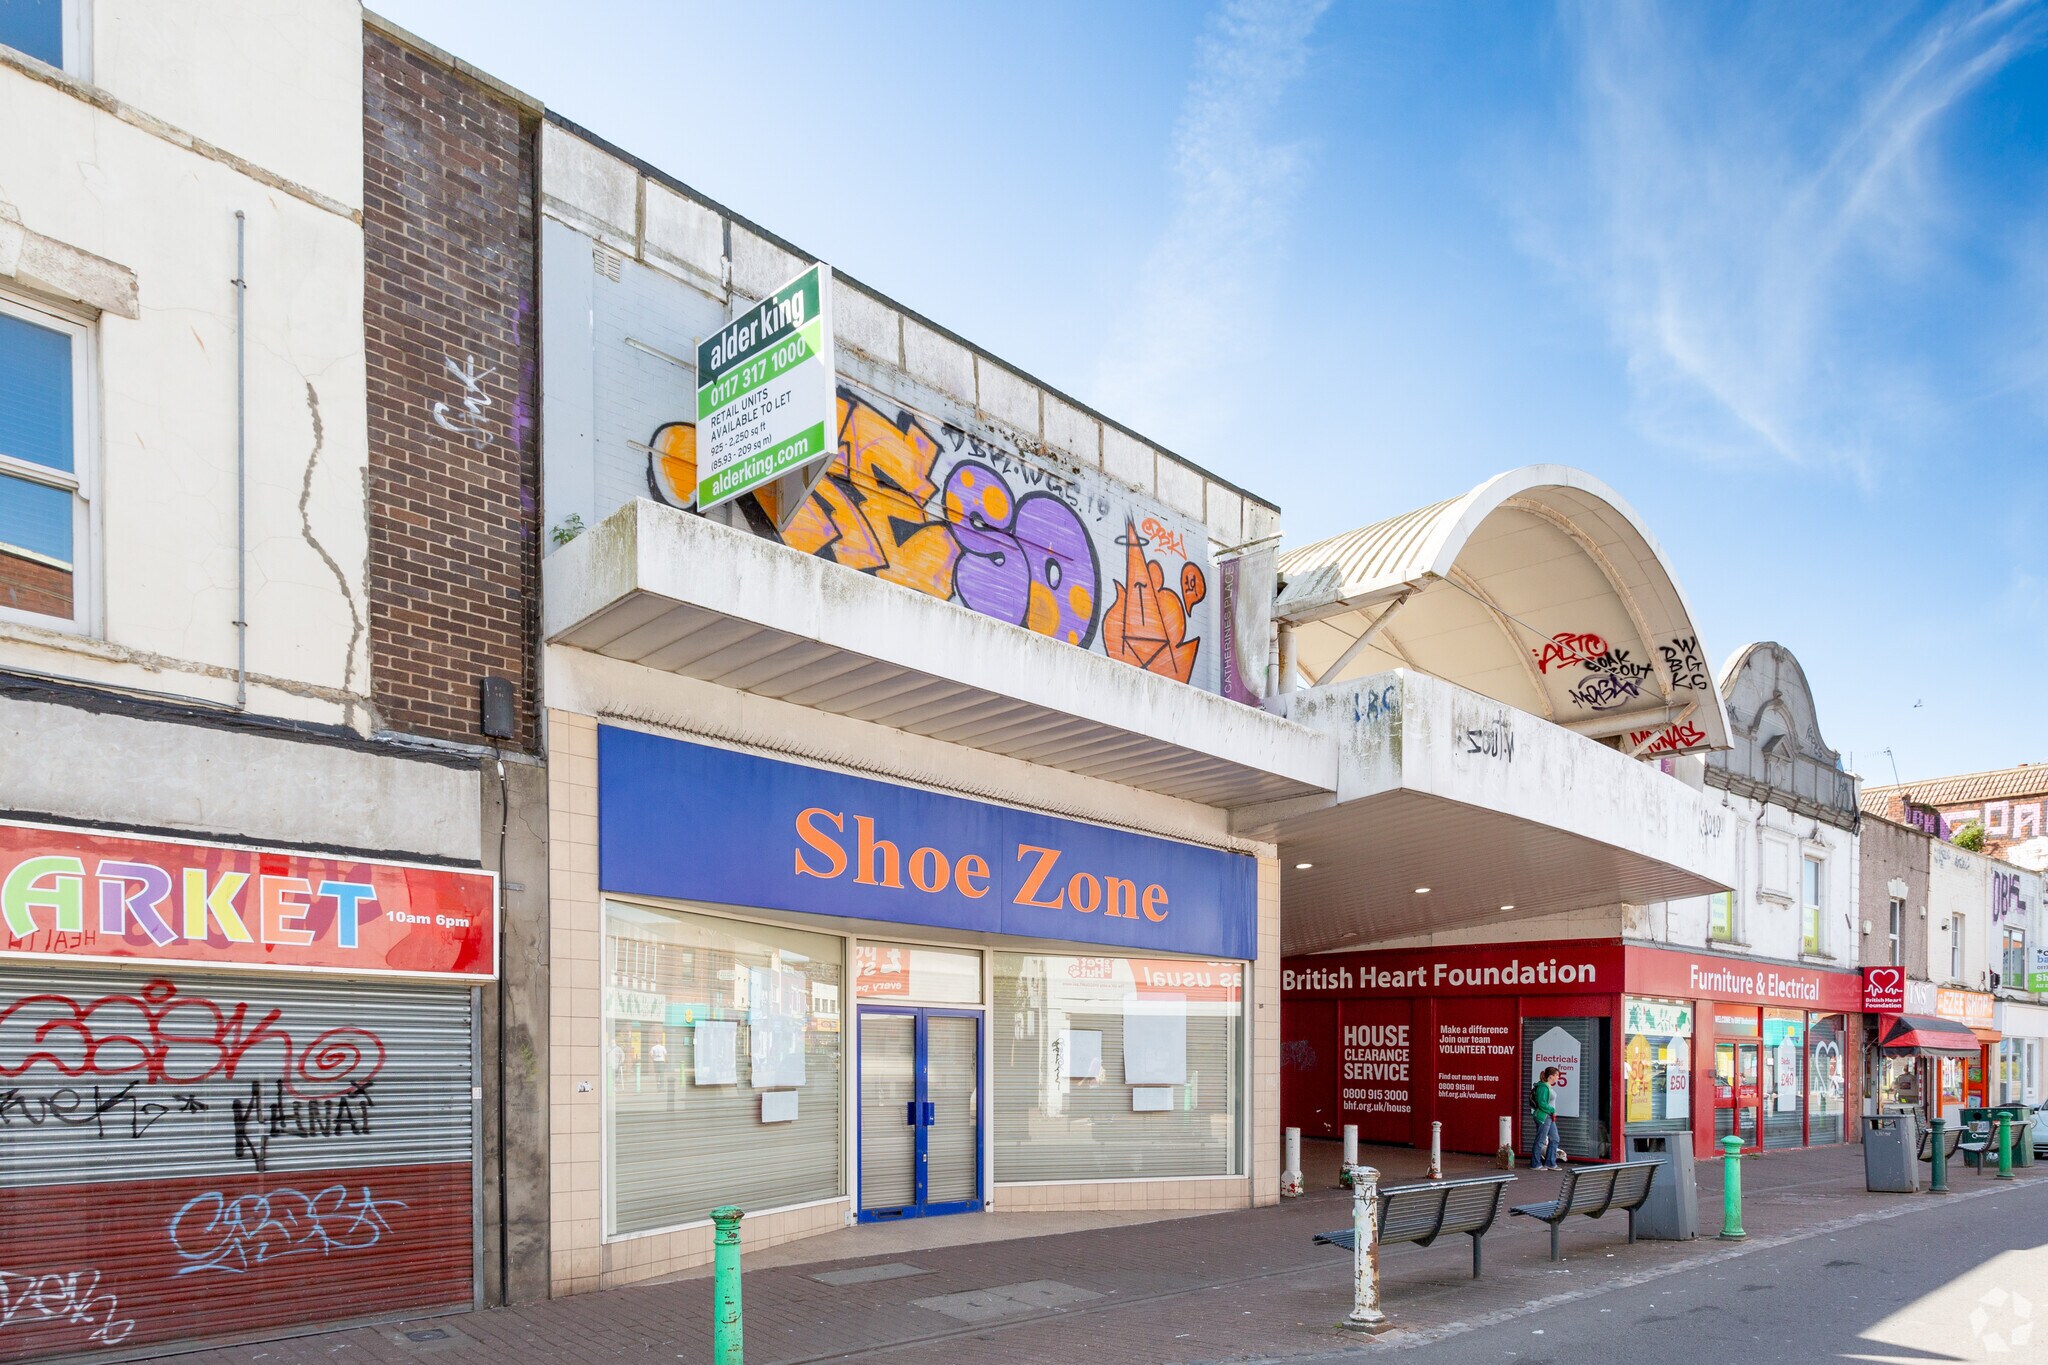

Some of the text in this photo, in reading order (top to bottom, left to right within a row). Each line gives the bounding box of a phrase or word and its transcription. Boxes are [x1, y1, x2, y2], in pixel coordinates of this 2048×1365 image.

[710, 289, 804, 371] alder king
[711, 337, 806, 406] 0117 317 1000
[711, 388, 769, 428] RETAIL UNITS
[711, 391, 792, 442] AVAILABLE TO LET
[711, 442, 723, 457] 925
[729, 432, 750, 448] 2,250
[750, 427, 760, 441] sq
[760, 422, 766, 434] ft
[711, 453, 732, 472] (85.93
[738, 444, 753, 458] 209
[753, 441, 762, 453] sq
[762, 434, 772, 448] m)
[711, 436, 809, 496] alderking.com
[1224, 564, 1235, 694] CATHERINES PLACE
[794, 807, 1169, 923] Shoe Zone
[1, 855, 470, 949] ARKET 10am 6pm
[1282, 959, 1596, 991] British Heart Foundation
[1690, 964, 1819, 1000] Furniture & Electrical
[1344, 1025, 1410, 1047] HOUSE
[1439, 1035, 1456, 1044] Join
[1471, 1035, 1491, 1044] team
[1440, 1025, 1461, 1034] Make
[1468, 1025, 1509, 1034] difference
[1344, 1048, 1410, 1062] CLEARANCE
[1439, 1045, 1515, 1055] VOLUNTEER TODAY
[1535, 1053, 1578, 1063] Electricals
[1344, 1062, 1410, 1081] SERVICE
[1438, 1072, 1451, 1080] Find
[1780, 1073, 1794, 1087] £40
[1438, 1082, 1454, 1090] 0800
[1670, 1075, 1686, 1091] £50
[1343, 1088, 1408, 1101] 0800 915 3000
[1438, 1091, 1497, 1100] bhf.org.uk/volunteer
[1343, 1100, 1411, 1113] bhf.org.uk/house
